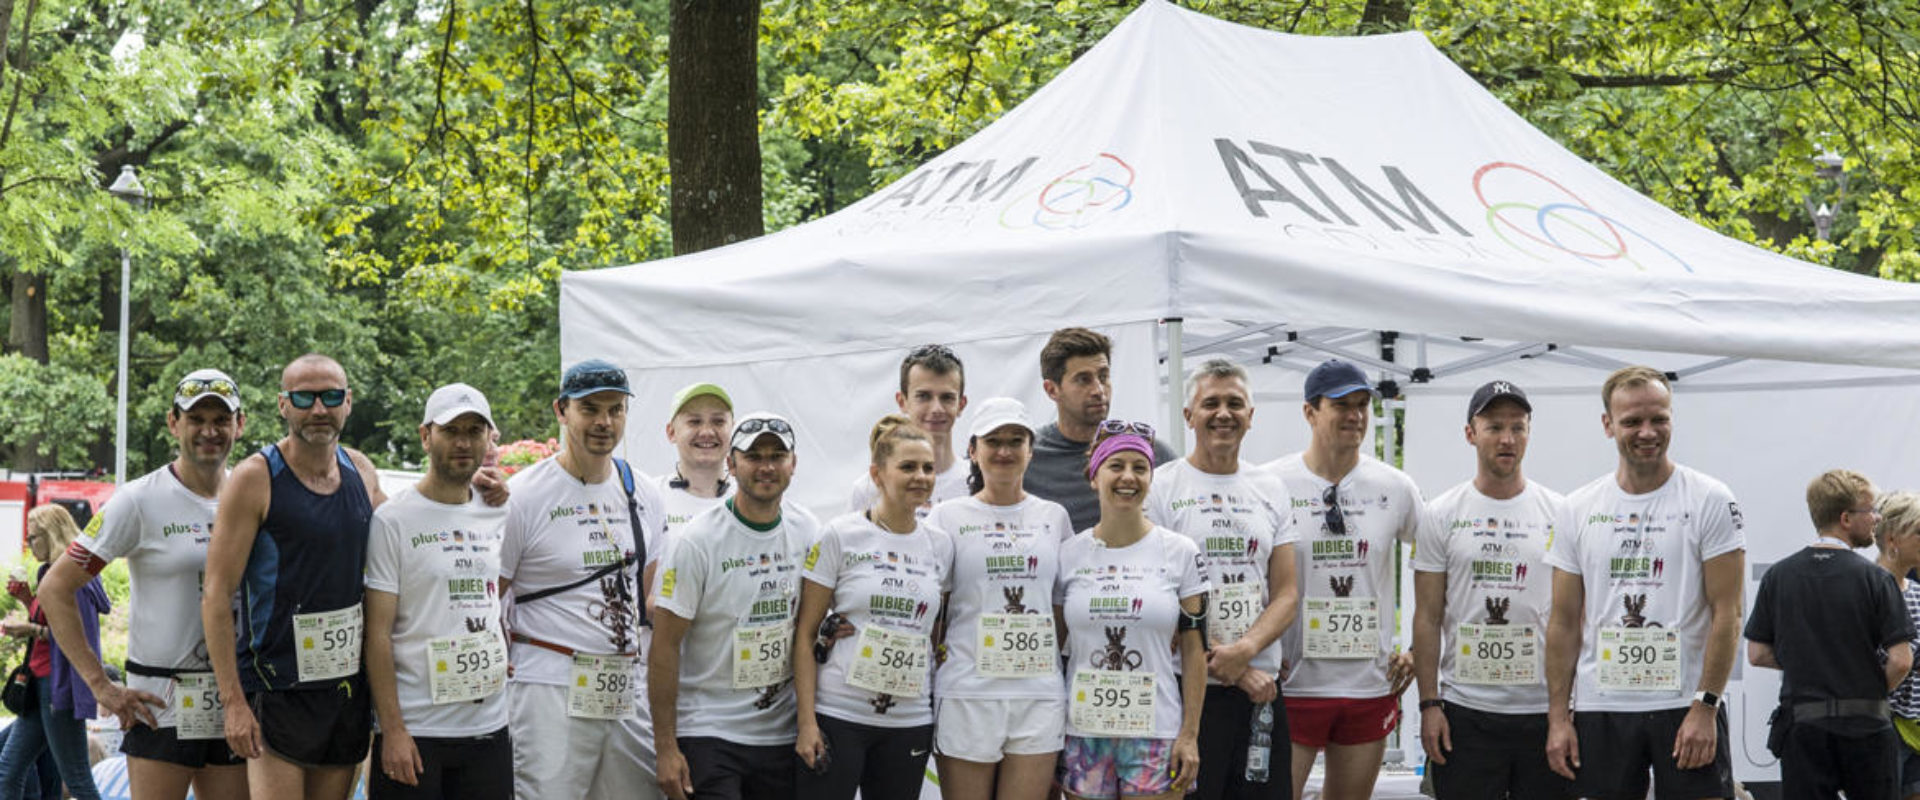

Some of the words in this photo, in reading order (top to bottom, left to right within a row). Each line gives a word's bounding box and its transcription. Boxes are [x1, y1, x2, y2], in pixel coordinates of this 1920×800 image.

[864, 155, 1041, 213] ATM
[1214, 138, 1474, 237] ATM
[1493, 382, 1511, 393] NY
[550, 506, 575, 520] plus
[1171, 499, 1197, 511] plus
[1212, 519, 1232, 529] ATM
[1588, 512, 1614, 525] plus
[163, 522, 191, 537] plus
[588, 531, 607, 541] ATM
[411, 531, 439, 549] plus
[1325, 539, 1353, 553] BIEG
[1481, 543, 1502, 553] ATM
[1620, 539, 1641, 550] ATM
[722, 557, 746, 573] plus
[1485, 561, 1512, 576] BIEG
[1624, 557, 1650, 571] BIEG
[882, 578, 904, 588] ATM
[762, 599, 788, 614] BIEG
[885, 595, 915, 612] BIEG
[1219, 600, 1250, 620] 591
[1327, 613, 1363, 633] 578
[323, 626, 355, 651] 597
[1002, 631, 1040, 651] 586
[759, 637, 788, 662] 581
[1477, 641, 1515, 660] 805
[1618, 645, 1657, 665] 590
[456, 649, 490, 674] 593
[879, 647, 915, 670] 584
[595, 672, 628, 693] 589
[1092, 687, 1131, 709] 595
